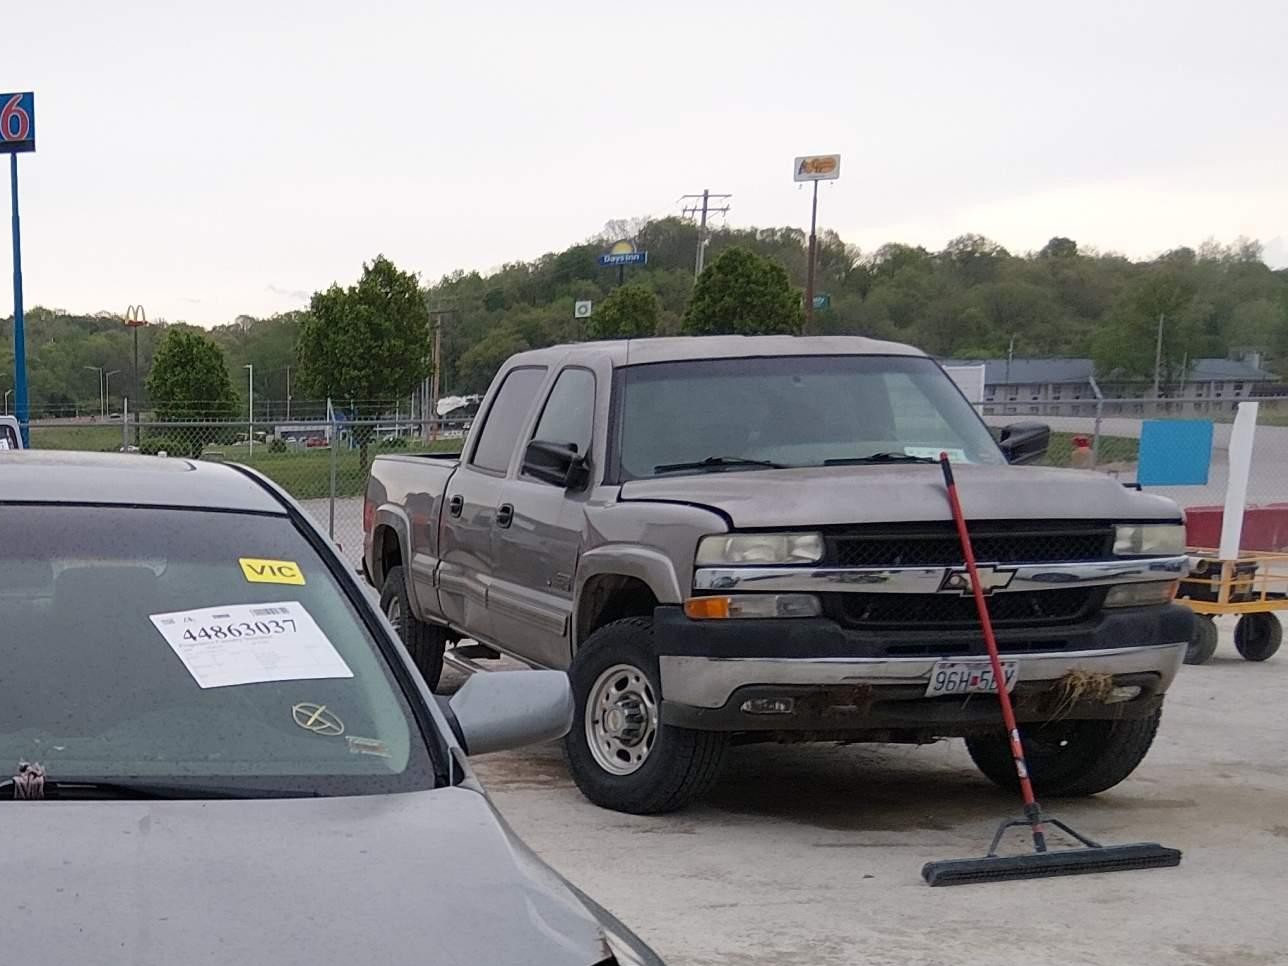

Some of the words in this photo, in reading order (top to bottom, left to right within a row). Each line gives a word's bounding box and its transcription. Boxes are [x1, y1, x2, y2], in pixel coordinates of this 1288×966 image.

[0, 94, 30, 141] 6
[604, 255, 624, 264] Days
[246, 563, 297, 577] VIC
[182, 619, 297, 641] 44863037
[933, 670, 972, 692] 96H
